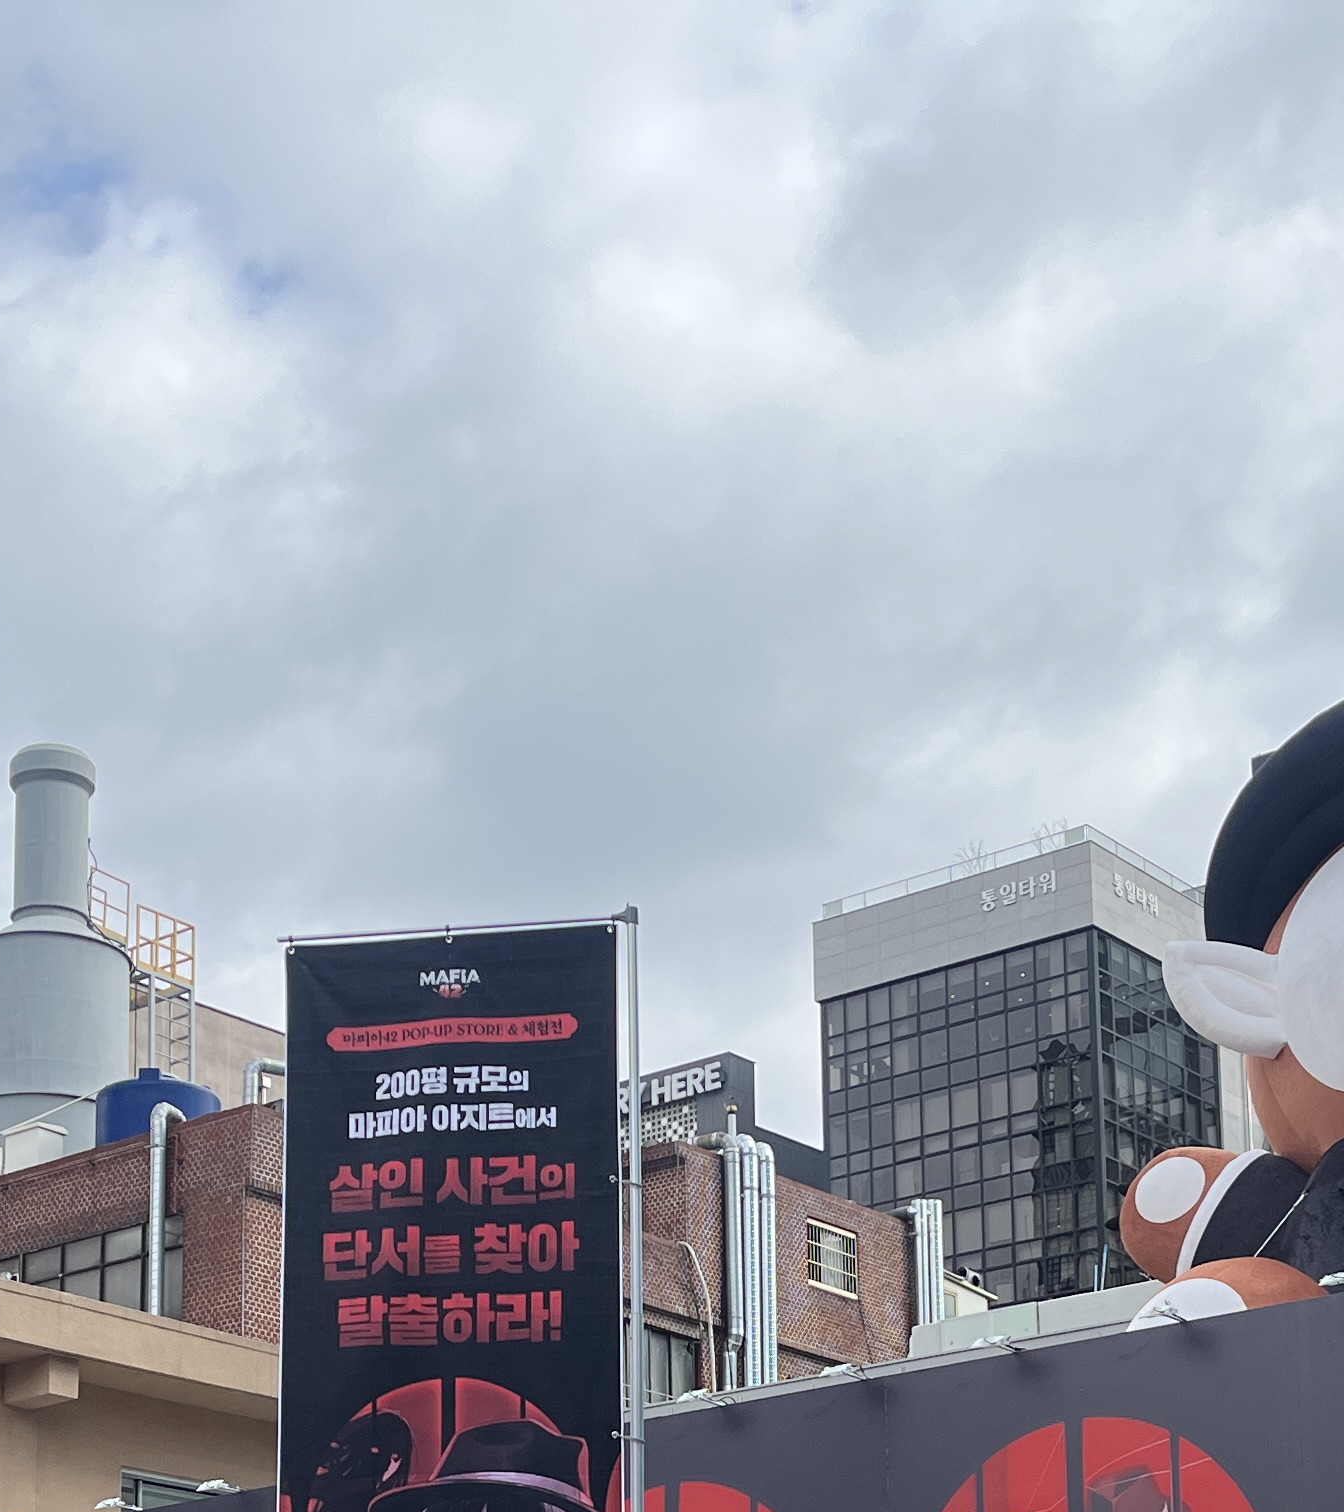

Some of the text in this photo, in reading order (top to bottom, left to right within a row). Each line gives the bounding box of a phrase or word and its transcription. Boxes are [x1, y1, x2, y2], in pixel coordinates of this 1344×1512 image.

[979, 870, 1057, 913] 통일타워
[1113, 873, 1160, 918] 통일타워
[419, 968, 481, 987] MAFIA
[401, 1024, 453, 1042] POP-UP
[456, 1021, 504, 1038] STORE
[507, 1022, 519, 1036] &
[522, 1018, 564, 1038] 체험전
[375, 1065, 529, 1101] 200평 규모의
[651, 1061, 722, 1106] HERE
[348, 1102, 557, 1139] 마피아 아지트에서
[329, 1155, 576, 1213] 살인 사건의
[322, 1221, 581, 1281] 단서를 찾아
[337, 1290, 563, 1348] 탈출하라!
